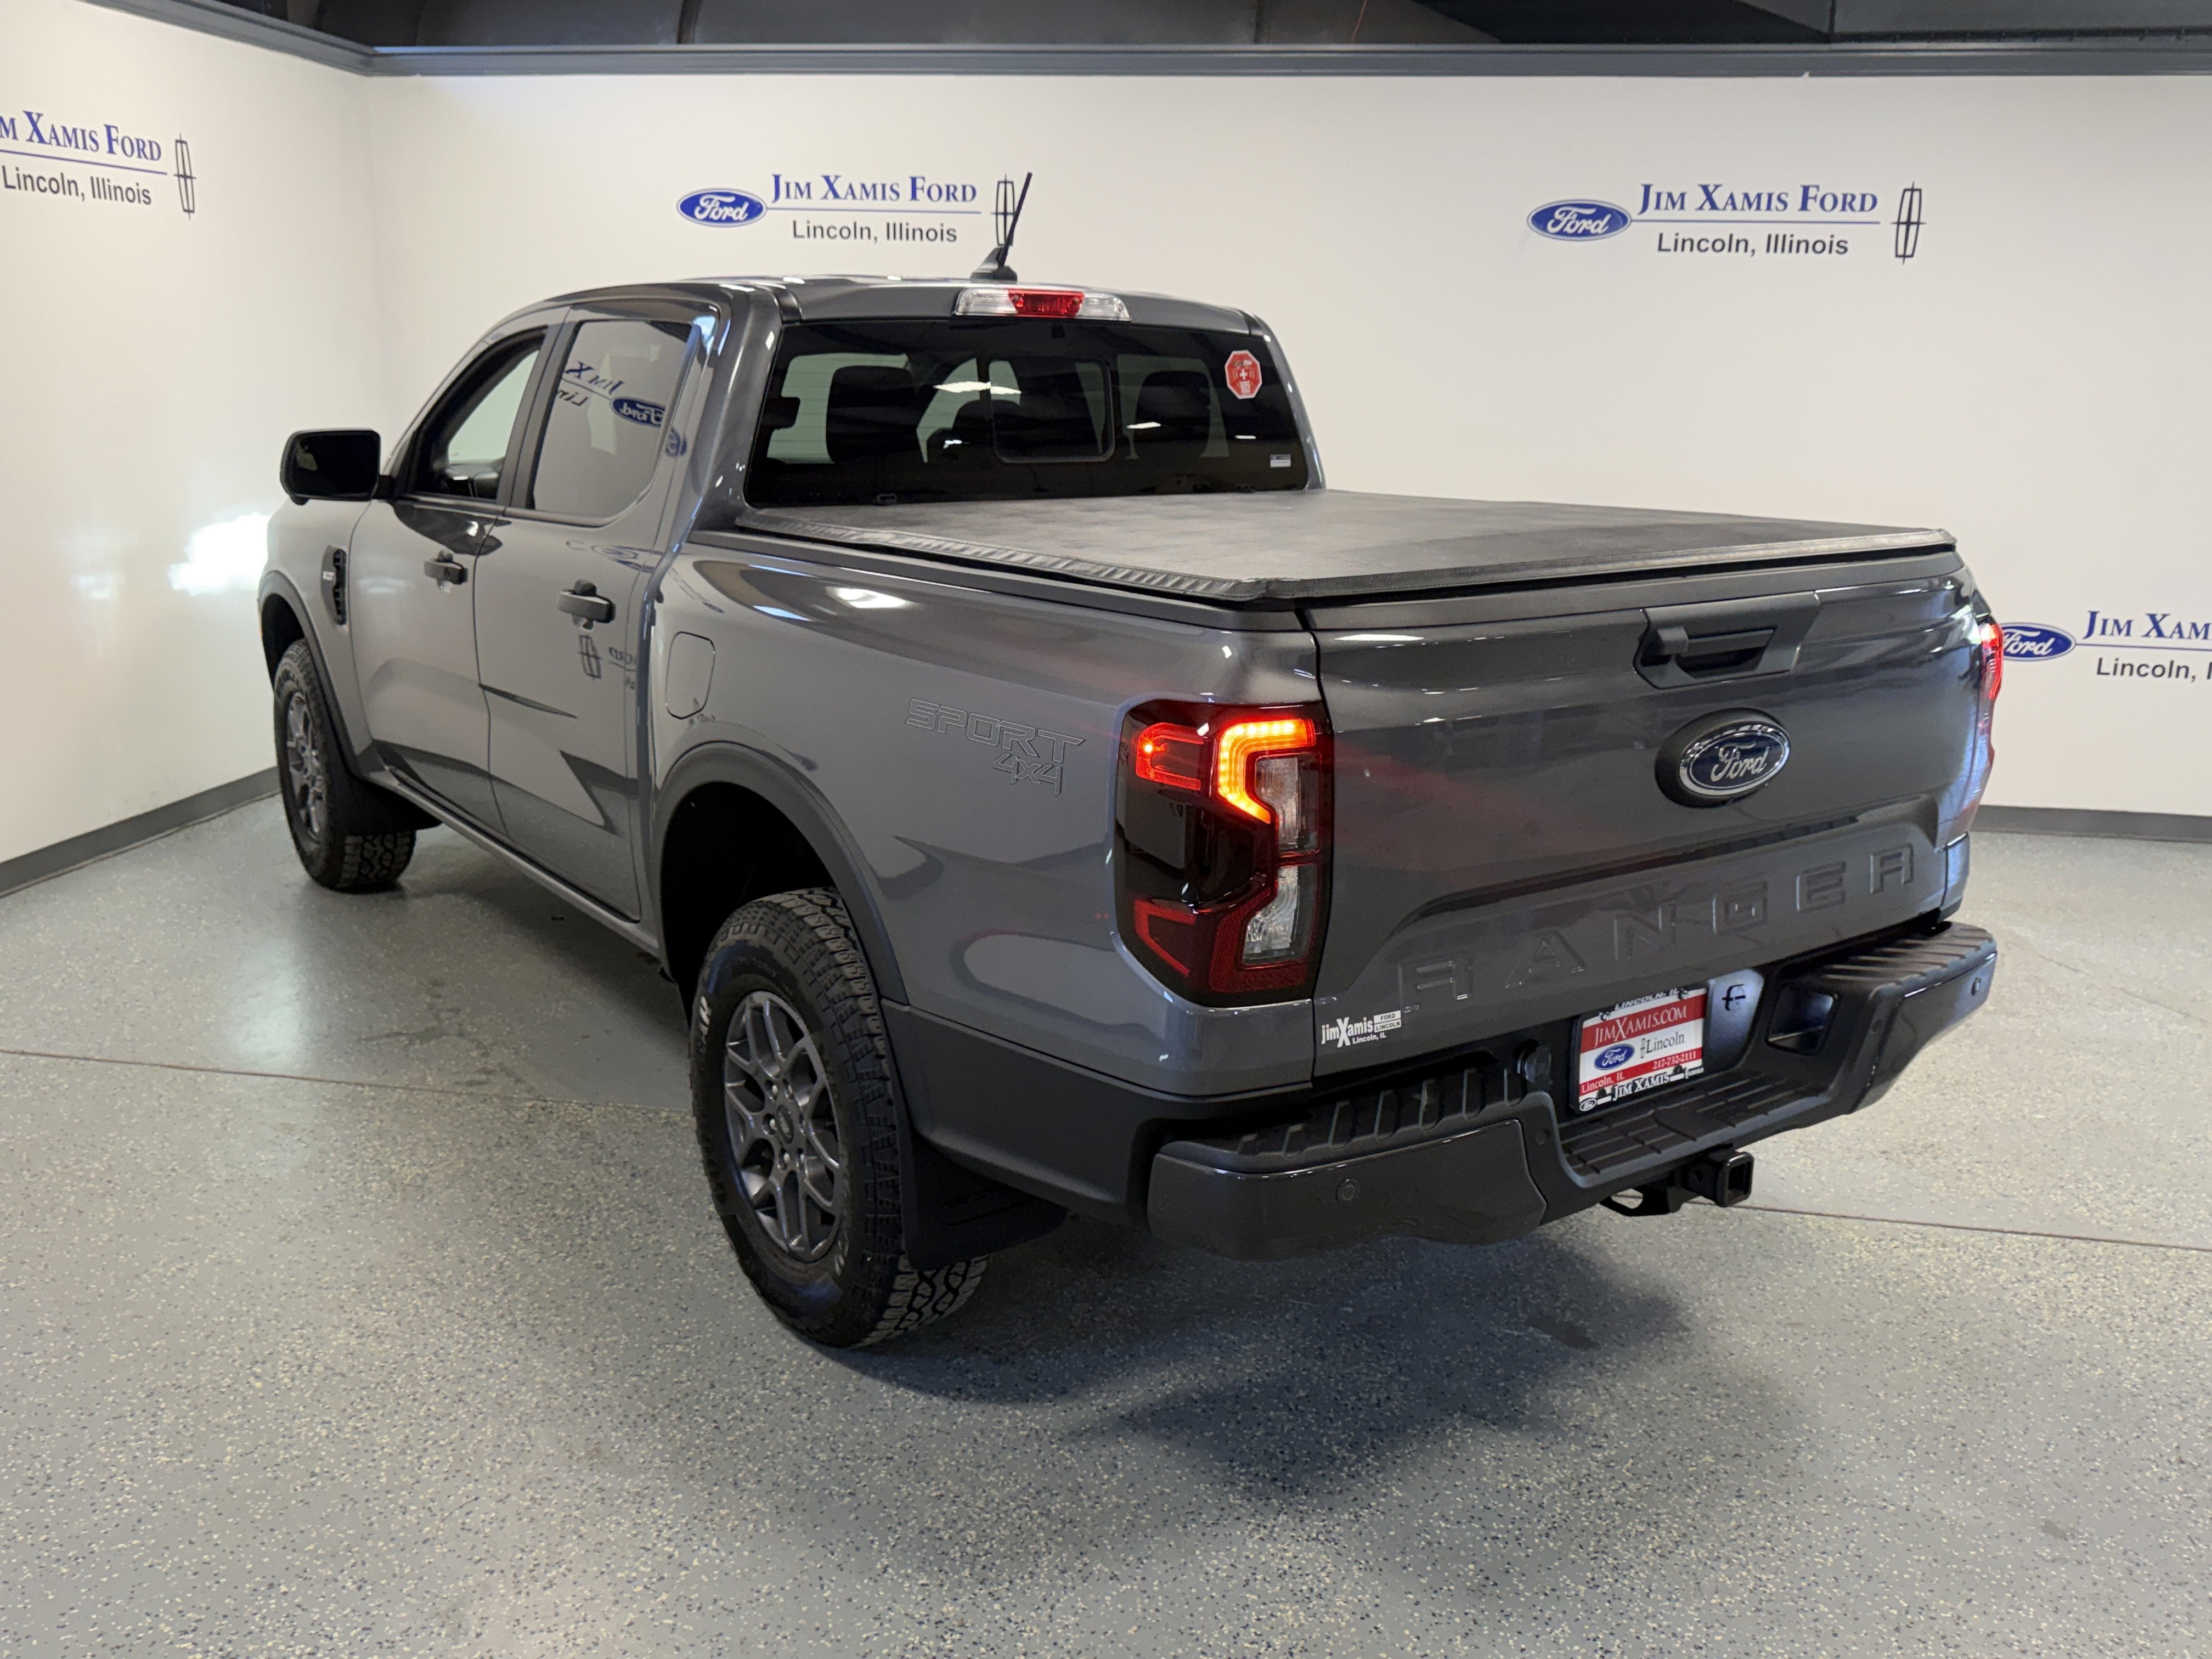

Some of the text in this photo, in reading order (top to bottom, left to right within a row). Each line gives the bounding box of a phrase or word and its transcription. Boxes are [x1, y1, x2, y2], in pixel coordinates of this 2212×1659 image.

[2, 166, 152, 206] Lincoln, Illinois
[694, 194, 749, 222] Ford
[1547, 207, 1610, 235] Ford
[793, 221, 957, 244] Lincoln, Illinois
[1657, 232, 1849, 257] Lincoln, Illinois
[2096, 657, 2197, 682] Lincoln,
[906, 698, 1087, 763] SPORT
[1710, 741, 1770, 782] Ford
[1397, 841, 1915, 1013] RANGER
[1375, 1021, 1401, 1031] LINCOLN
[1380, 1013, 1396, 1021] FORD
[1646, 1031, 1685, 1053] Lincoln
[1601, 1048, 1626, 1066] Ford
[1616, 1071, 1625, 1081] IL
[1653, 1051, 1697, 1070] 217-732-2111
